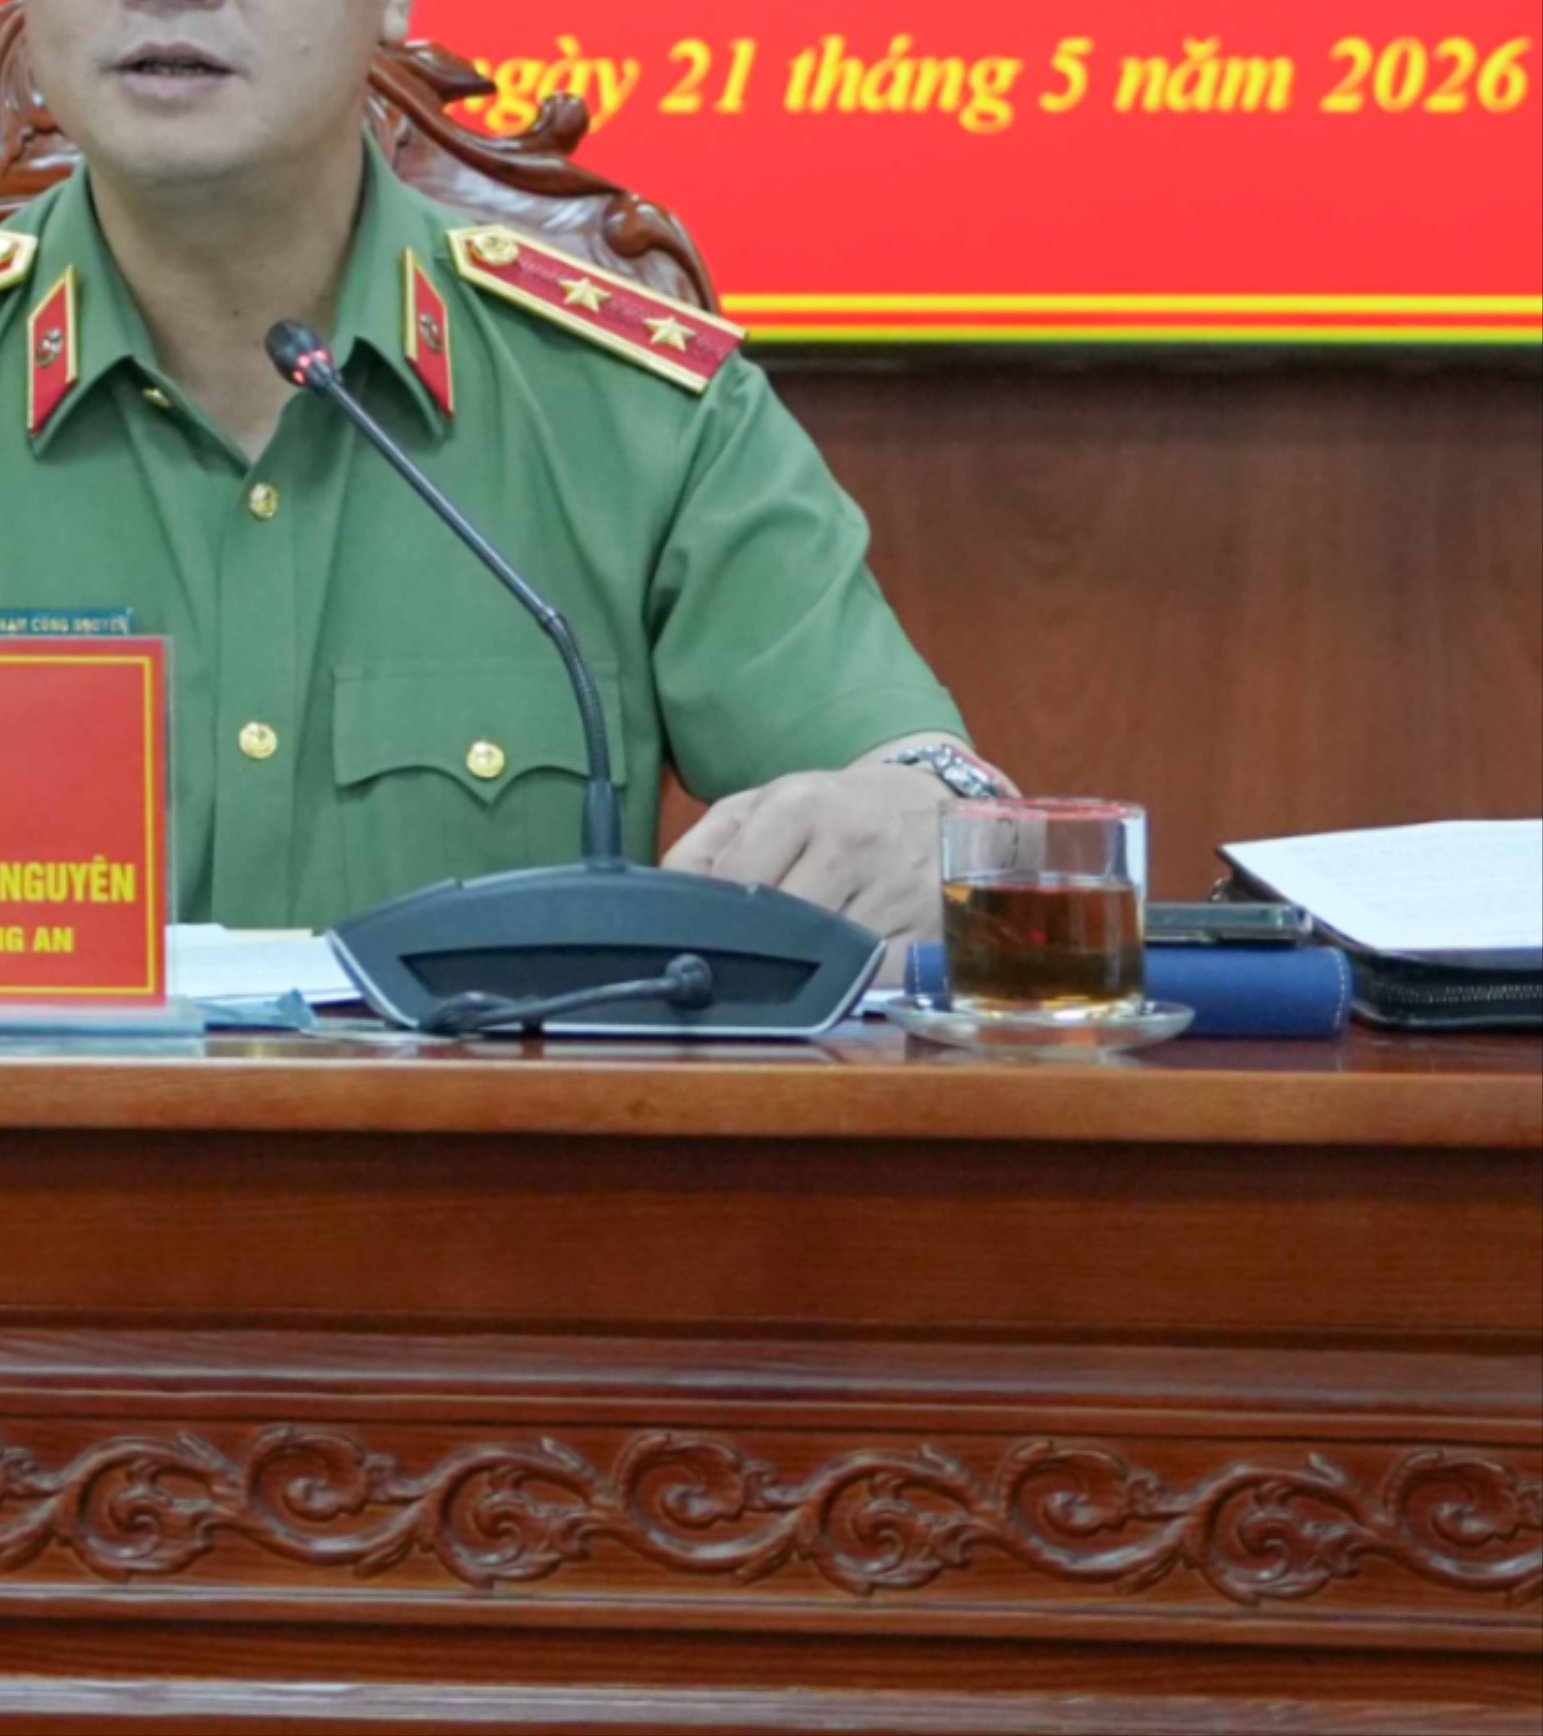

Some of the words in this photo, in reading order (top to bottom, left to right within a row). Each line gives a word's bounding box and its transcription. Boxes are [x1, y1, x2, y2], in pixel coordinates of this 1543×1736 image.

[660, 39, 755, 113] 21
[785, 35, 1021, 131] tháng
[1040, 37, 1092, 112] 5
[1115, 39, 1293, 111] năm
[1321, 37, 1528, 112] 2026
[33, 927, 74, 952] AN
